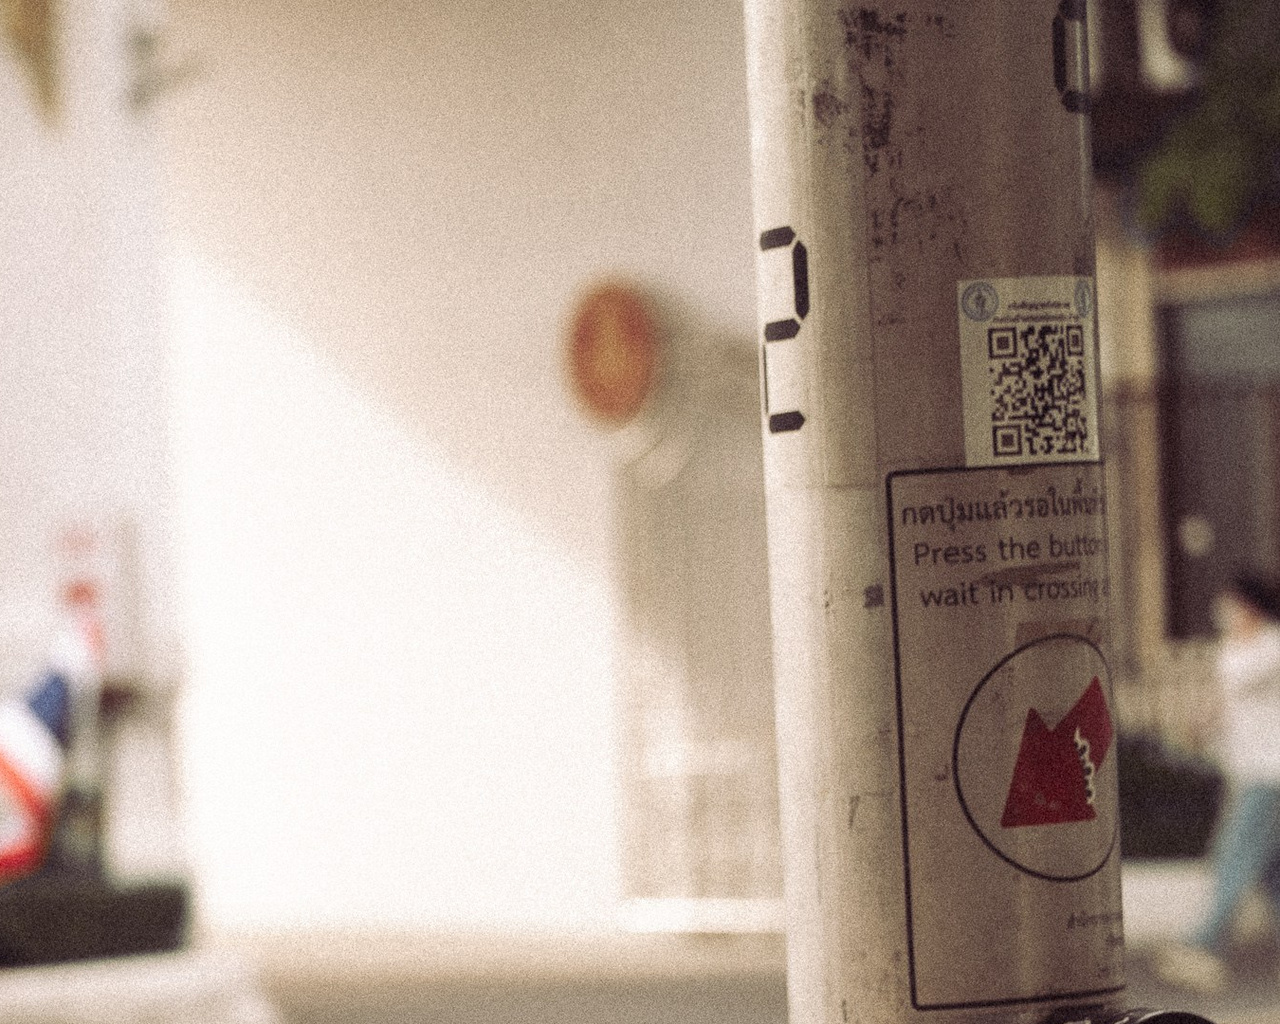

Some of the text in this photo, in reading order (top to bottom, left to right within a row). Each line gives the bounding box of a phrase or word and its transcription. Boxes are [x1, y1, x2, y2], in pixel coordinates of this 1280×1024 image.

[913, 542, 987, 566] Press
[997, 536, 1041, 561] the
[921, 581, 979, 608] wait
[990, 577, 1014, 604] in
